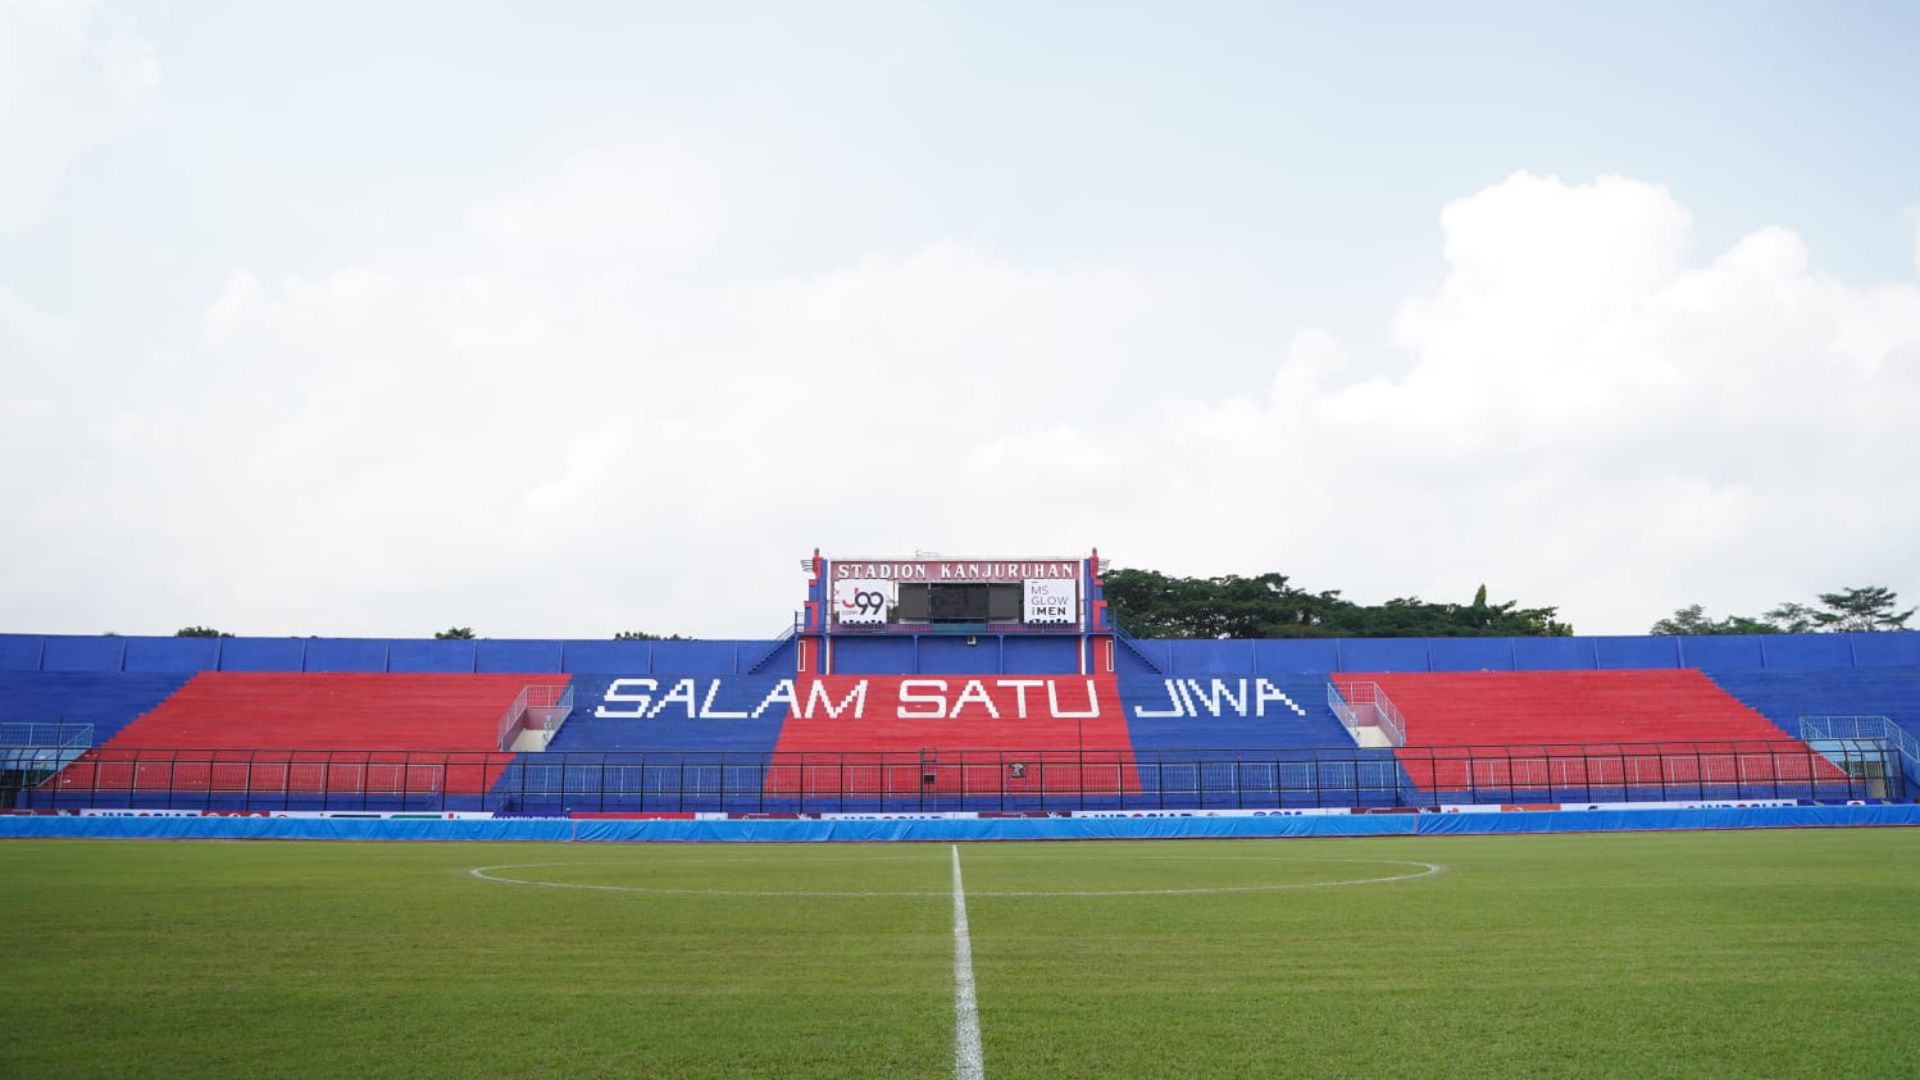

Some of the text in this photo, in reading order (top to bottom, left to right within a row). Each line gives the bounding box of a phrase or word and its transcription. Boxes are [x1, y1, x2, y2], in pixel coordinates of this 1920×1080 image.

[838, 563, 1073, 578] STADION KANJURUHAN
[1031, 585, 1049, 595] MS
[1031, 596, 1068, 606] GLOW
[594, 678, 1306, 719] SALAM SATU JIWA
